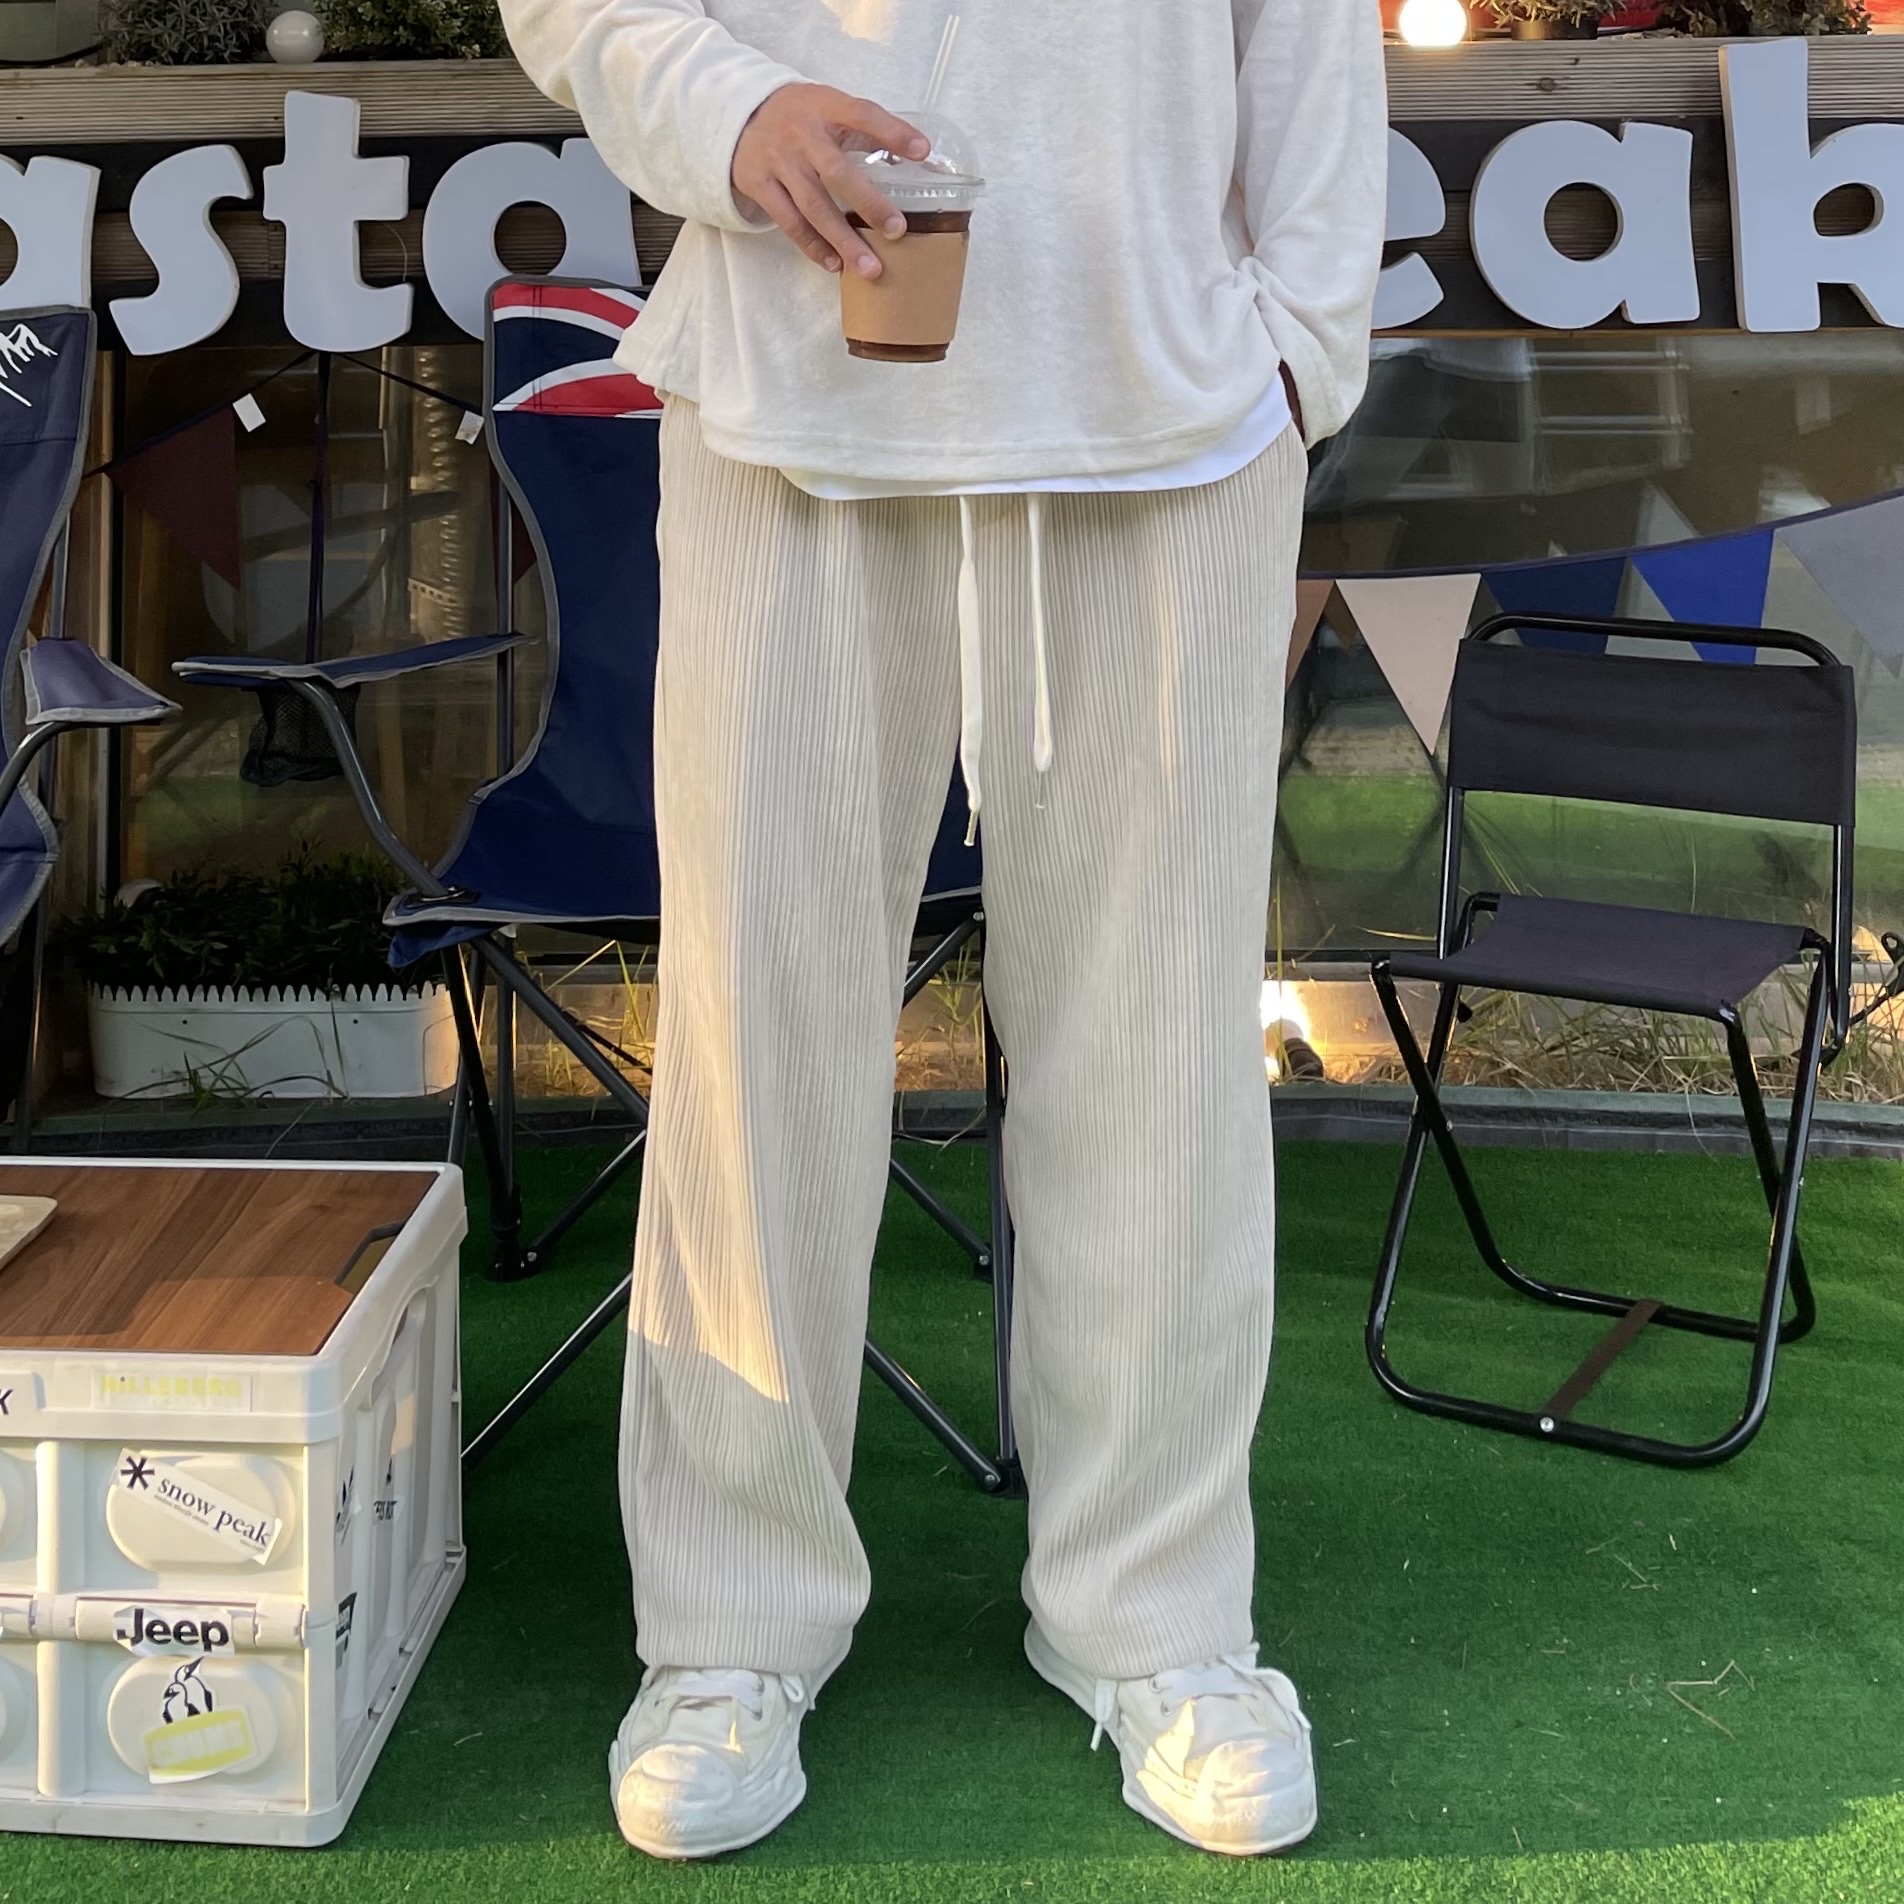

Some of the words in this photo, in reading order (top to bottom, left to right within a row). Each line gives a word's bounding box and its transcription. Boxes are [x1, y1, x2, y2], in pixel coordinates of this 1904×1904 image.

[157, 1477, 217, 1517] snow
[213, 1508, 272, 1548] peak
[116, 1607, 230, 1653] Jeep
